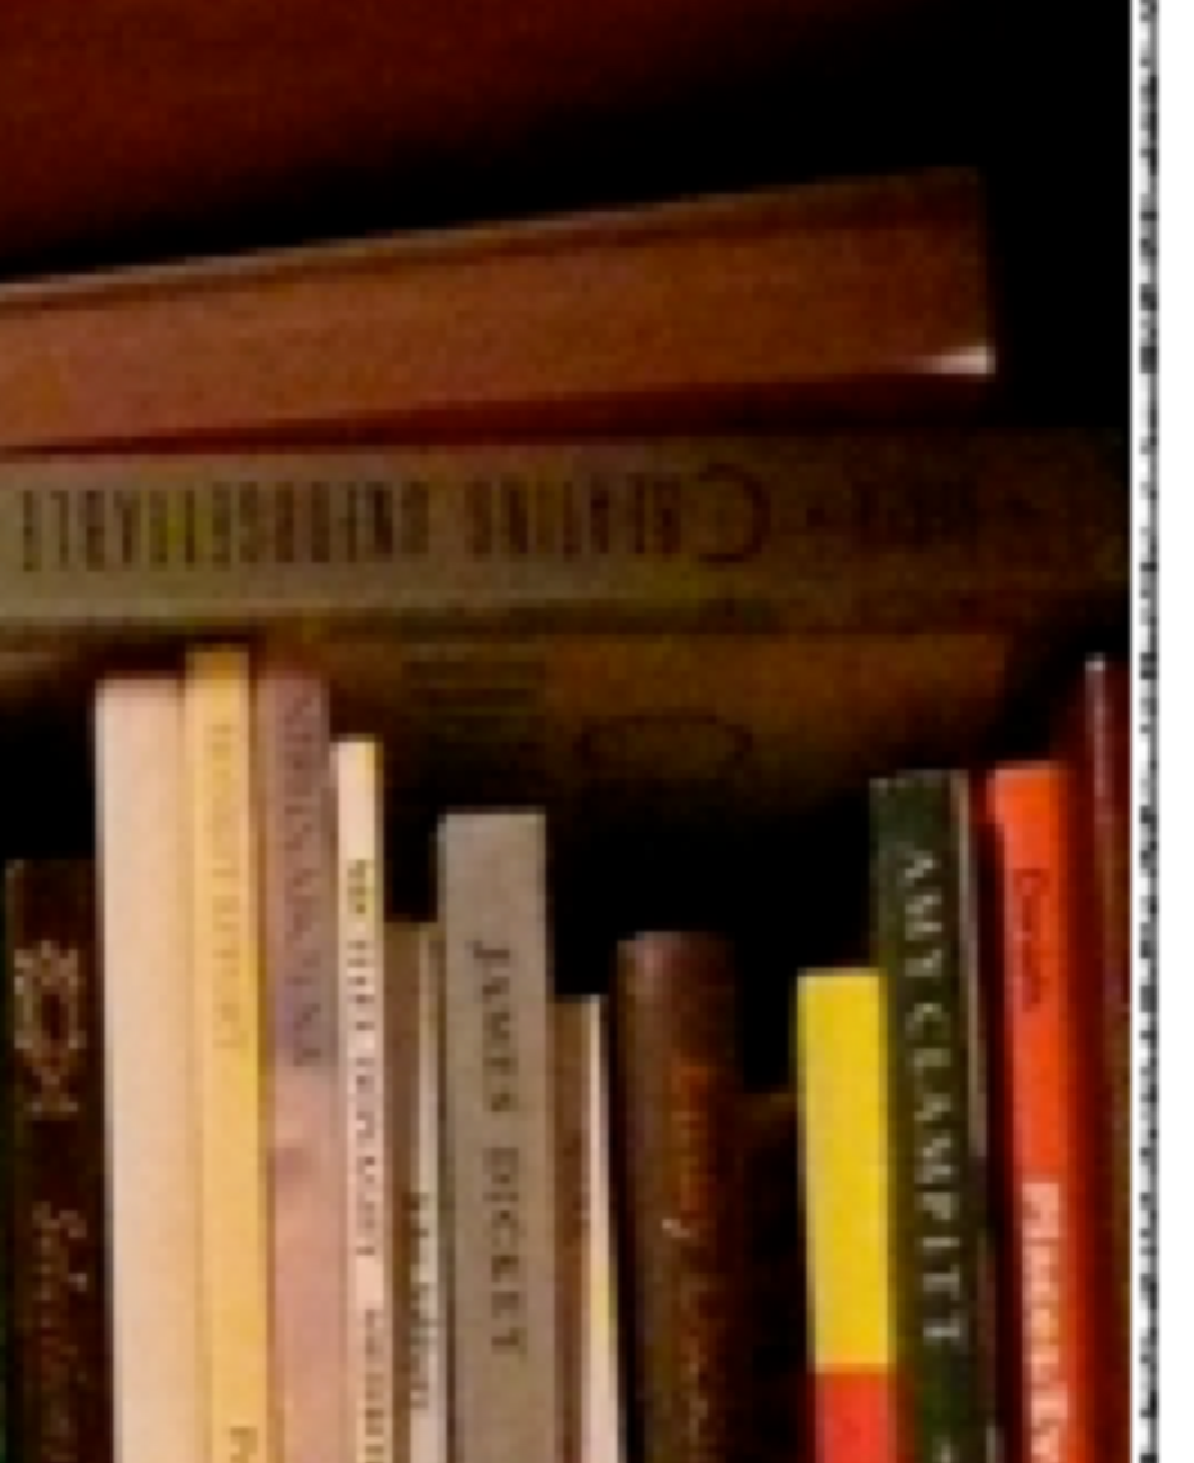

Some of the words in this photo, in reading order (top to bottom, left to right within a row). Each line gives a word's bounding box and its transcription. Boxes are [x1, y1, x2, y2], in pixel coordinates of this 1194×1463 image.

[900, 847, 947, 980] AMY
[471, 940, 525, 1115] JAMES
[483, 1147, 528, 1359] DICKEY
[913, 1001, 965, 1351] CLAMPITT
